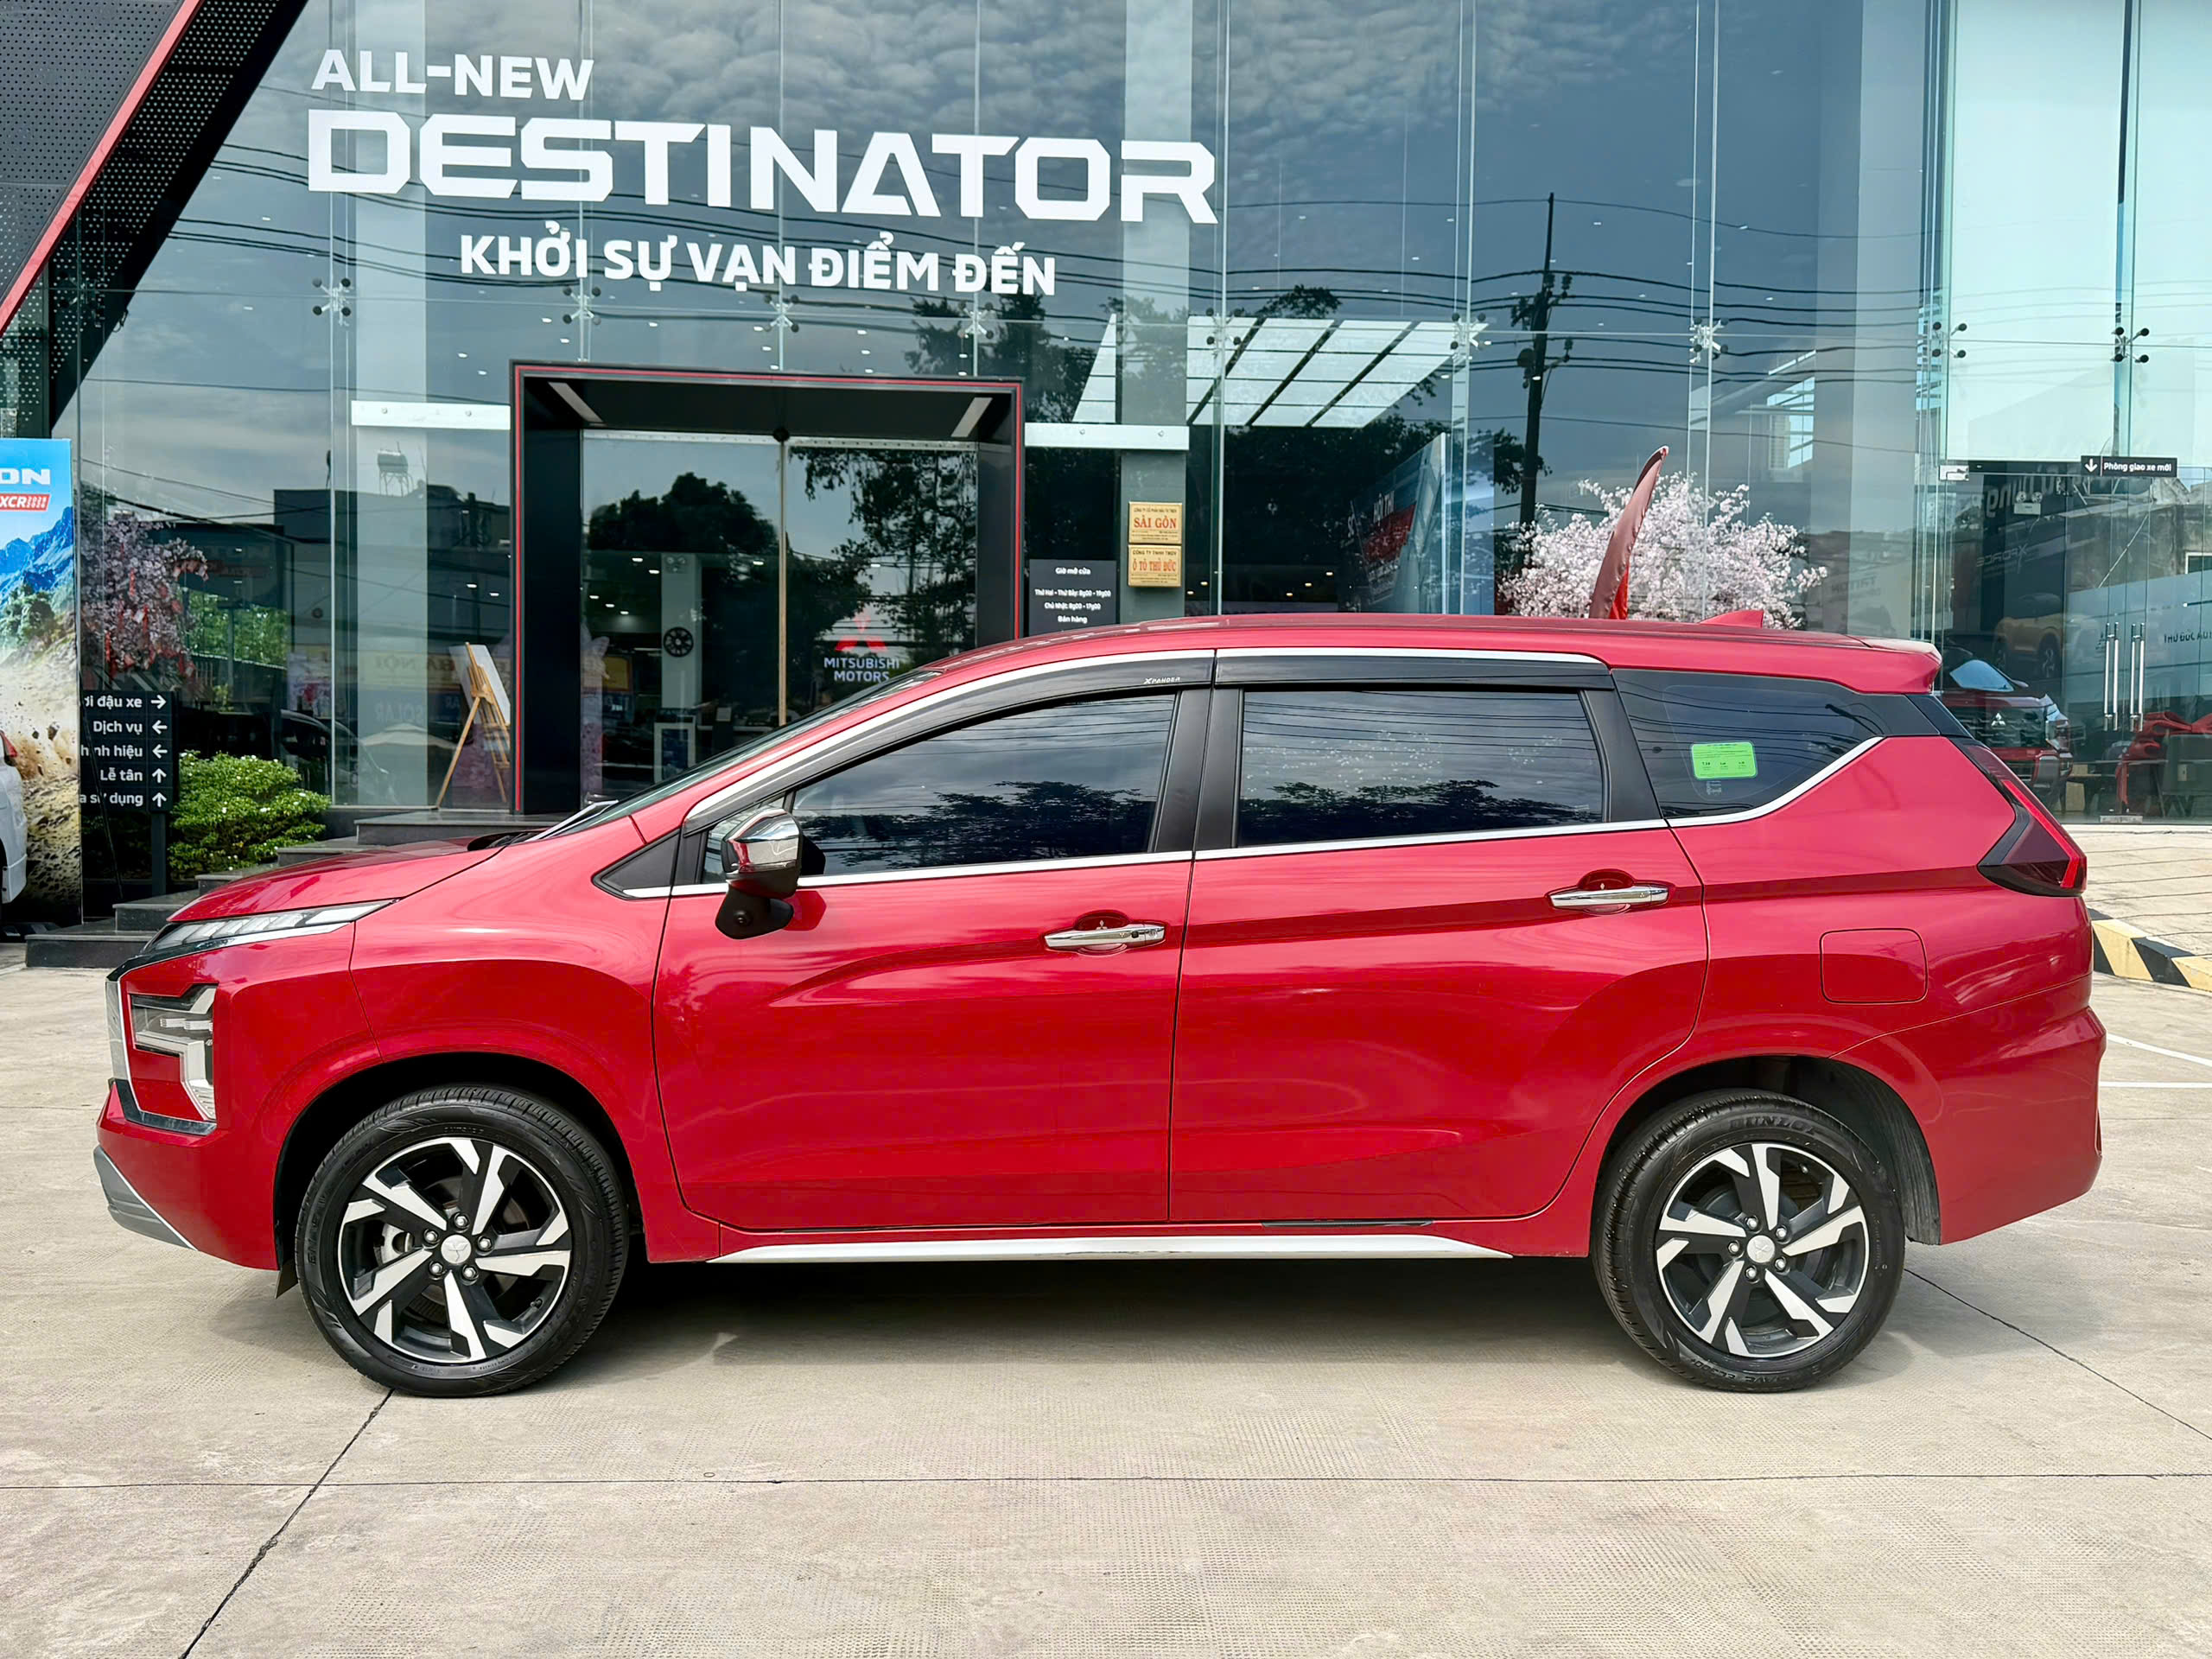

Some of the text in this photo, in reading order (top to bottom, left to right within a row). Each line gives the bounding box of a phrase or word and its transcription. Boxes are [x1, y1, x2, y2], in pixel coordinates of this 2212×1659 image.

[311, 49, 594, 101] ALL-NEW
[308, 109, 1218, 224] DESTINATOR
[461, 221, 1055, 296] KHỞI SỰ VẠN ĐIỂM ĐẾN
[2103, 462, 2128, 473] Phòng
[2129, 463, 2145, 473] giao
[2158, 463, 2172, 472] mới
[1134, 514, 1177, 529] SÀI GÒN
[823, 657, 899, 670] MITSUBISHI
[834, 671, 890, 683] MOTORS
[97, 695, 123, 710] đậu
[126, 697, 143, 708] xe
[92, 720, 143, 735] Dịch vụ
[113, 744, 143, 760] hiệu
[100, 766, 143, 782] Lễ tân
[109, 791, 143, 807] dụng
